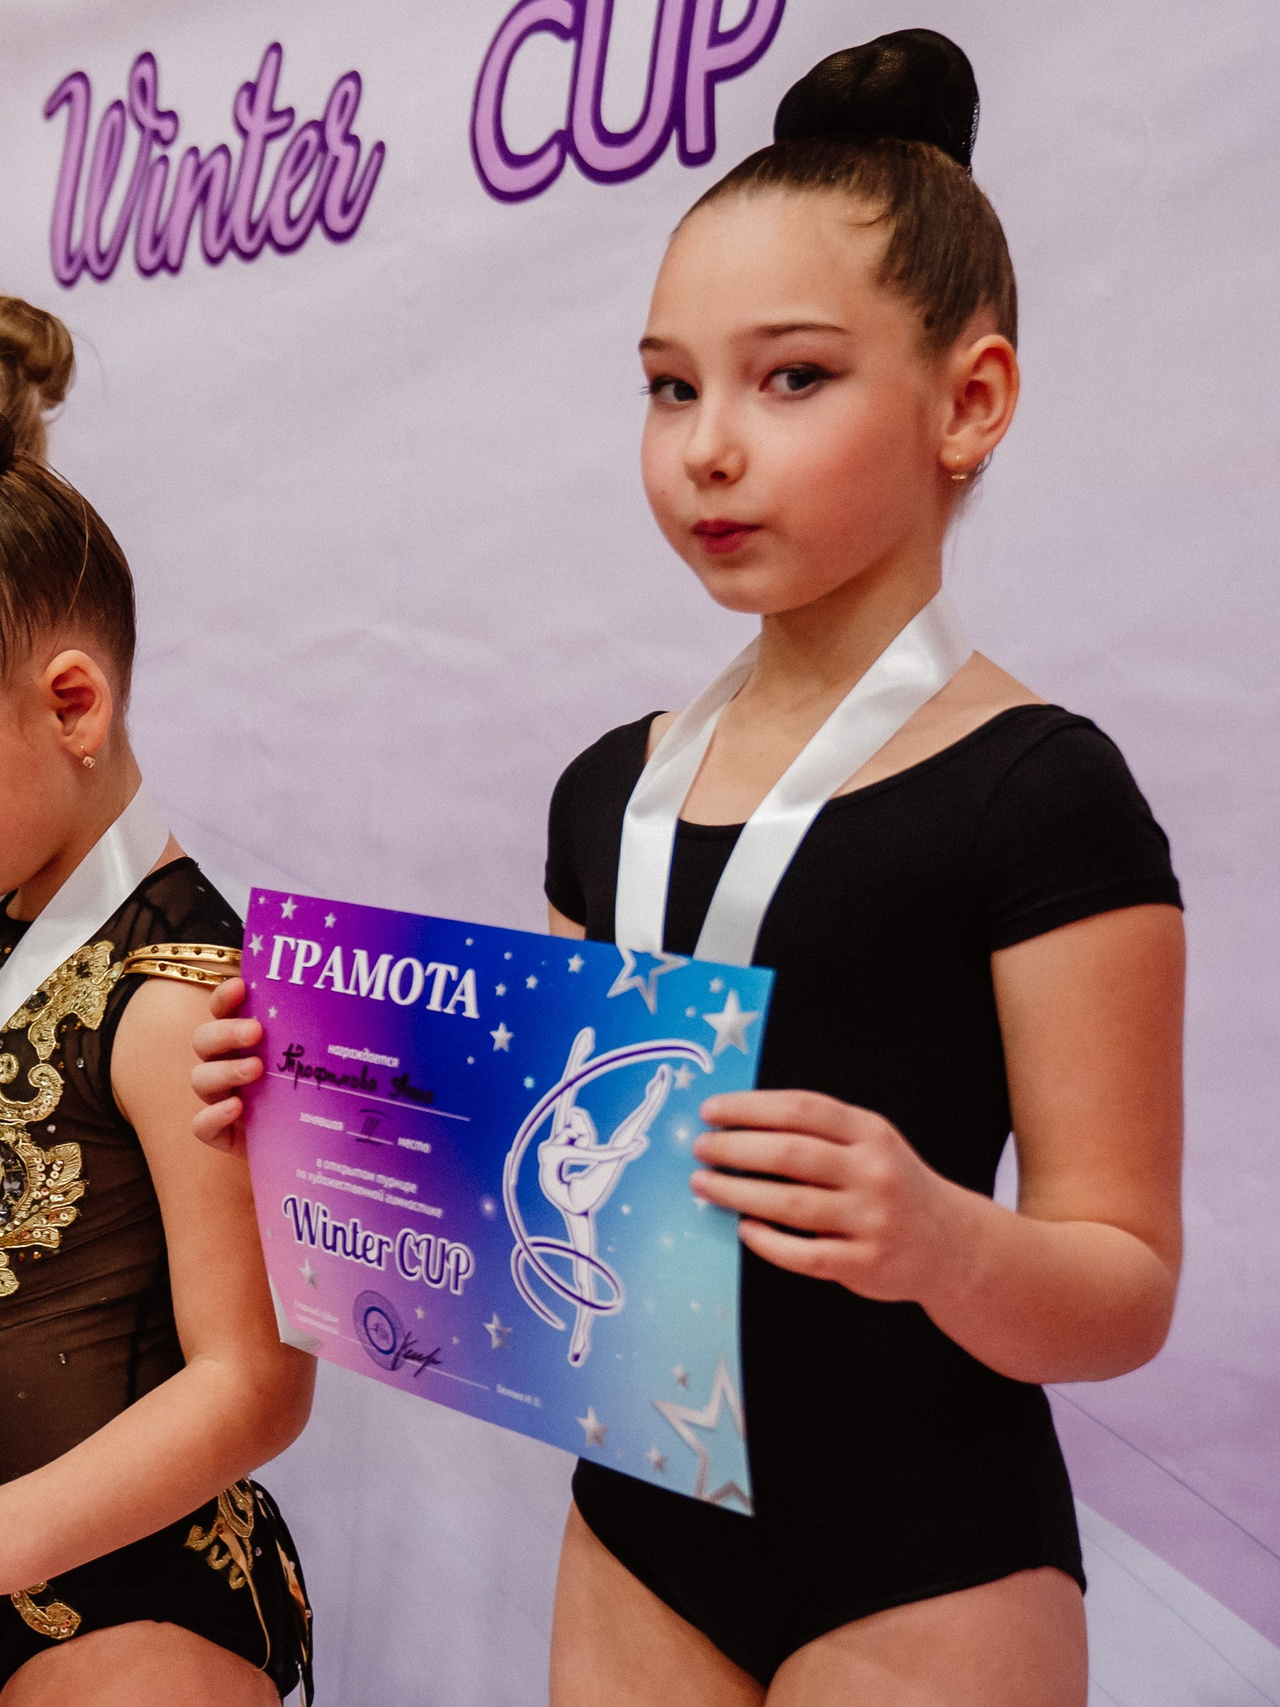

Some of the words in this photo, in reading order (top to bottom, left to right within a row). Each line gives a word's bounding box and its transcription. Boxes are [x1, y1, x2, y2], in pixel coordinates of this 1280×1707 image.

[44, 41, 386, 289] Winter
[470, 0, 787, 205] CUP
[266, 935, 480, 1019] ГРАМОТА
[281, 1194, 393, 1272] Winter
[395, 1228, 475, 1296] CUP
